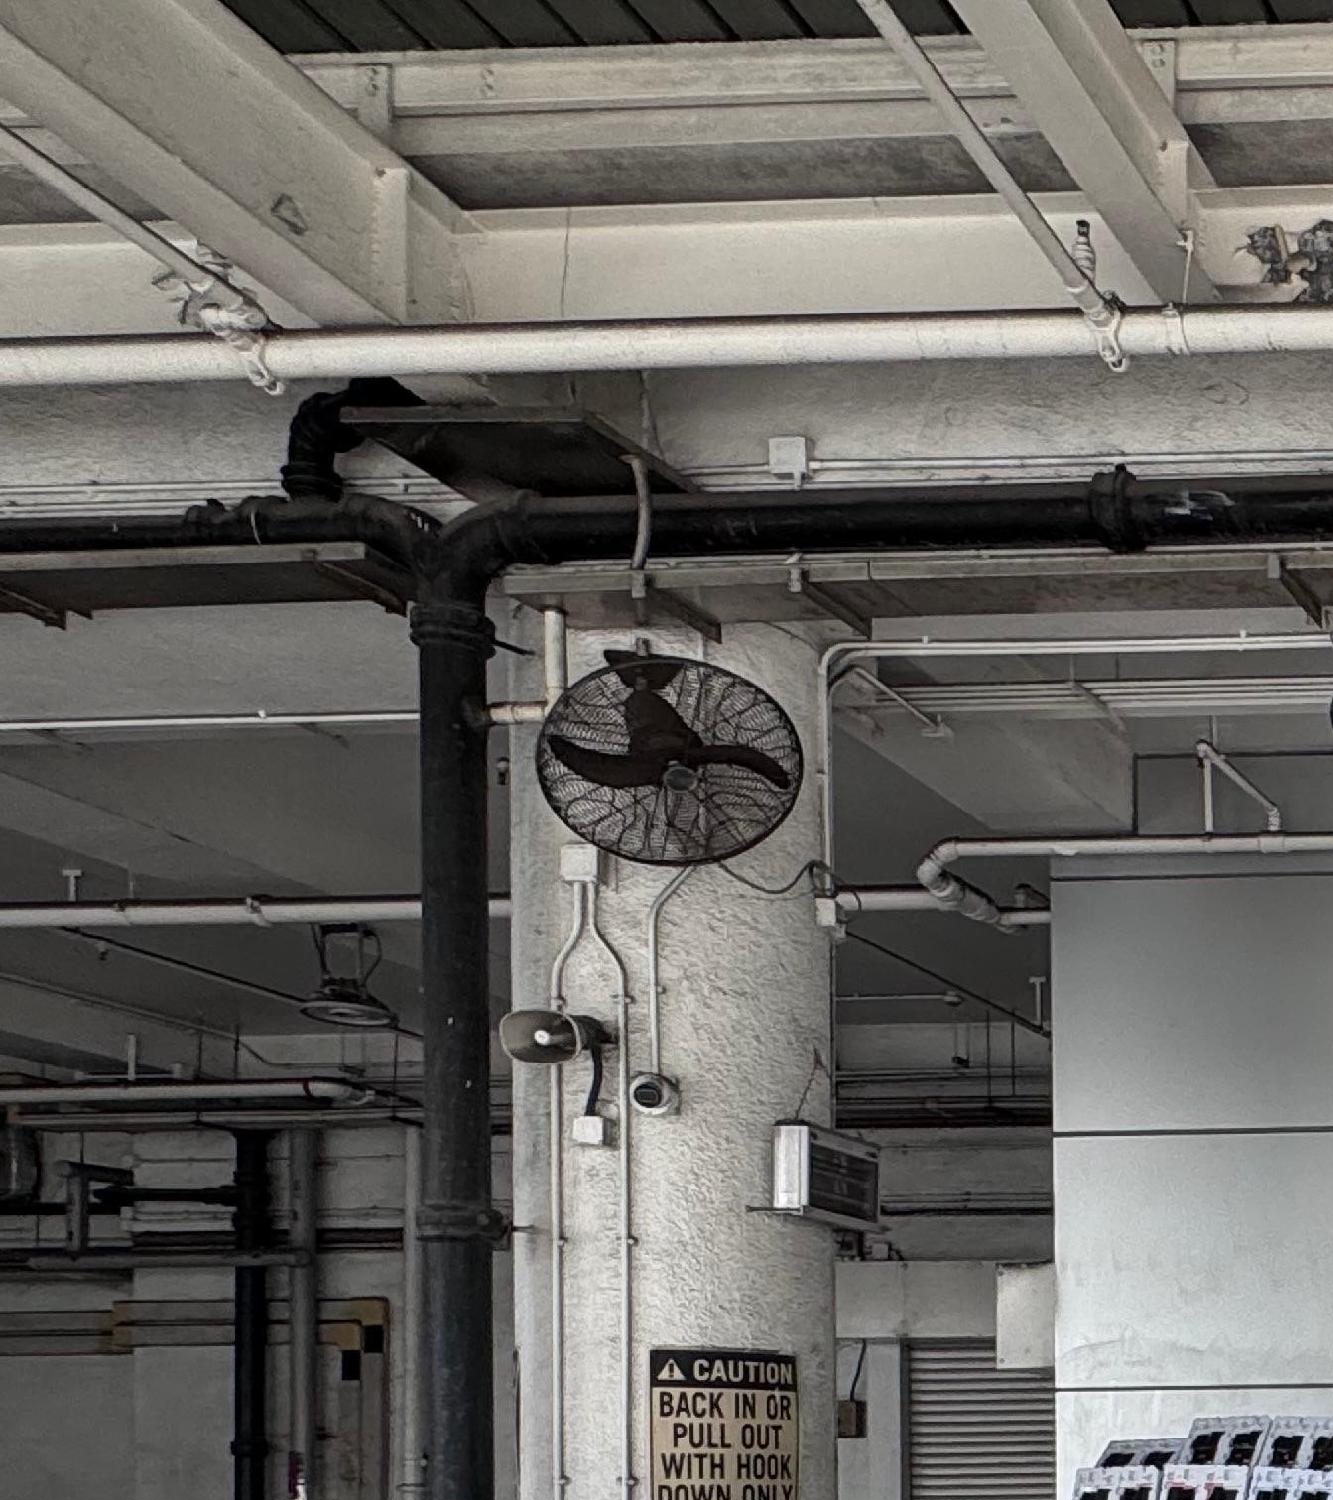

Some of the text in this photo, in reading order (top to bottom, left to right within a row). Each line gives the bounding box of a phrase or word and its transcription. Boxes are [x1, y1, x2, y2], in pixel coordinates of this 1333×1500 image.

[692, 1359, 794, 1385] CAUTION
[659, 1391, 792, 1421] BACK IN OR
[673, 1422, 783, 1450] PULL OUT
[661, 1452, 793, 1480] WITH HOOK
